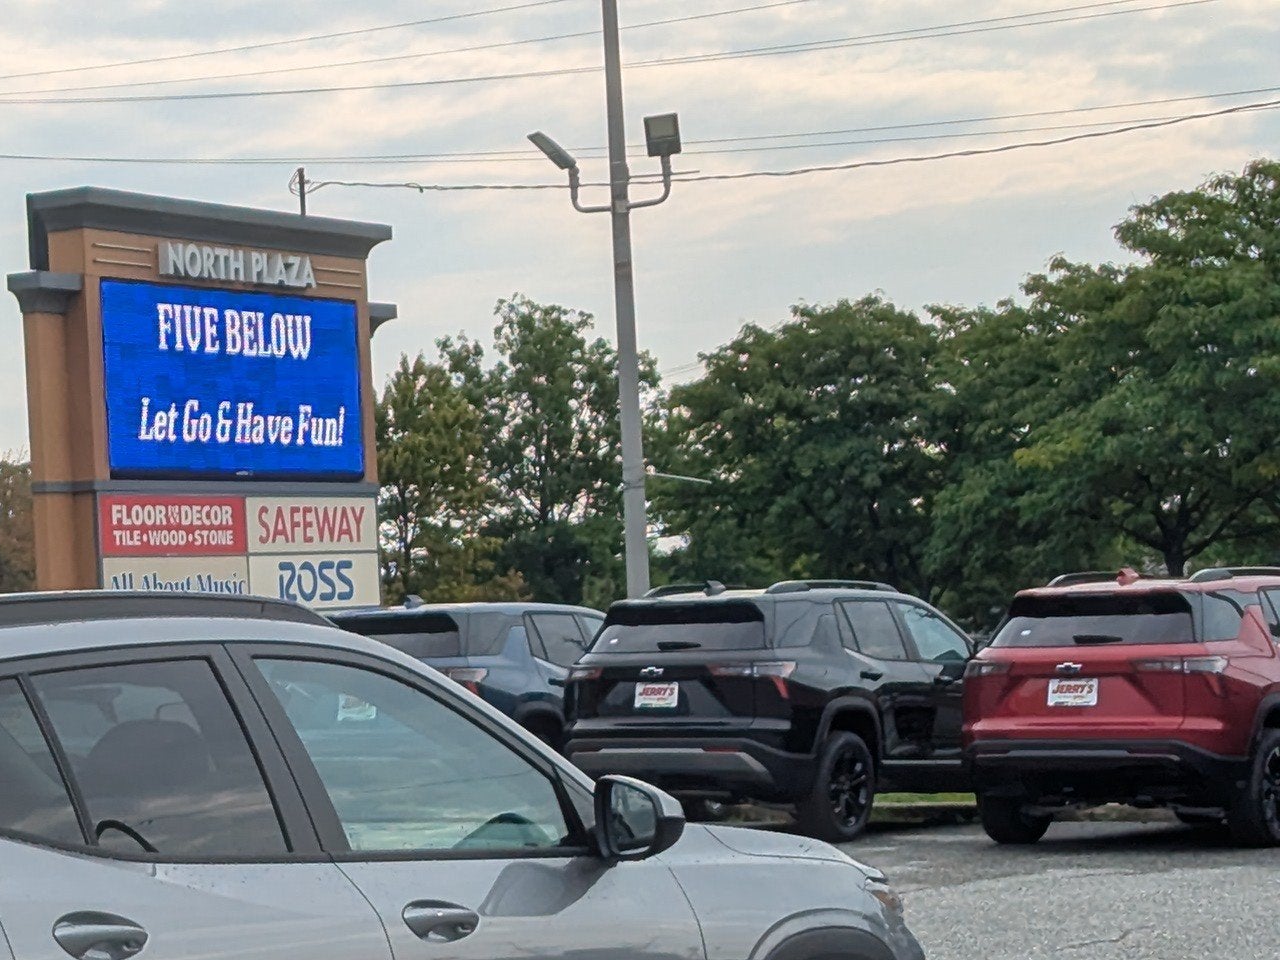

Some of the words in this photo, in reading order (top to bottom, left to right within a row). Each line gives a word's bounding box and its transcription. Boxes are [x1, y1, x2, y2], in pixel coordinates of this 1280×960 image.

[160, 241, 244, 283] NORTH
[251, 252, 317, 289] PLAZA
[157, 302, 219, 353] FIVE
[224, 309, 311, 361] BELOW
[138, 397, 179, 443] Let
[182, 399, 212, 443] Go
[216, 400, 233, 444] &
[235, 402, 293, 445] Have
[297, 404, 345, 447] Fun!
[111, 504, 167, 526] FLOOR
[180, 505, 234, 526] DECOR
[258, 505, 365, 544] SAFEWAY
[113, 530, 141, 546] TILE
[148, 530, 187, 546] WOOD
[194, 530, 234, 546] STONE
[111, 572, 133, 590] All
[142, 572, 192, 592] About
[197, 572, 246, 595] Music
[278, 560, 354, 602] ROSS
[639, 687, 675, 696] JERRY'S
